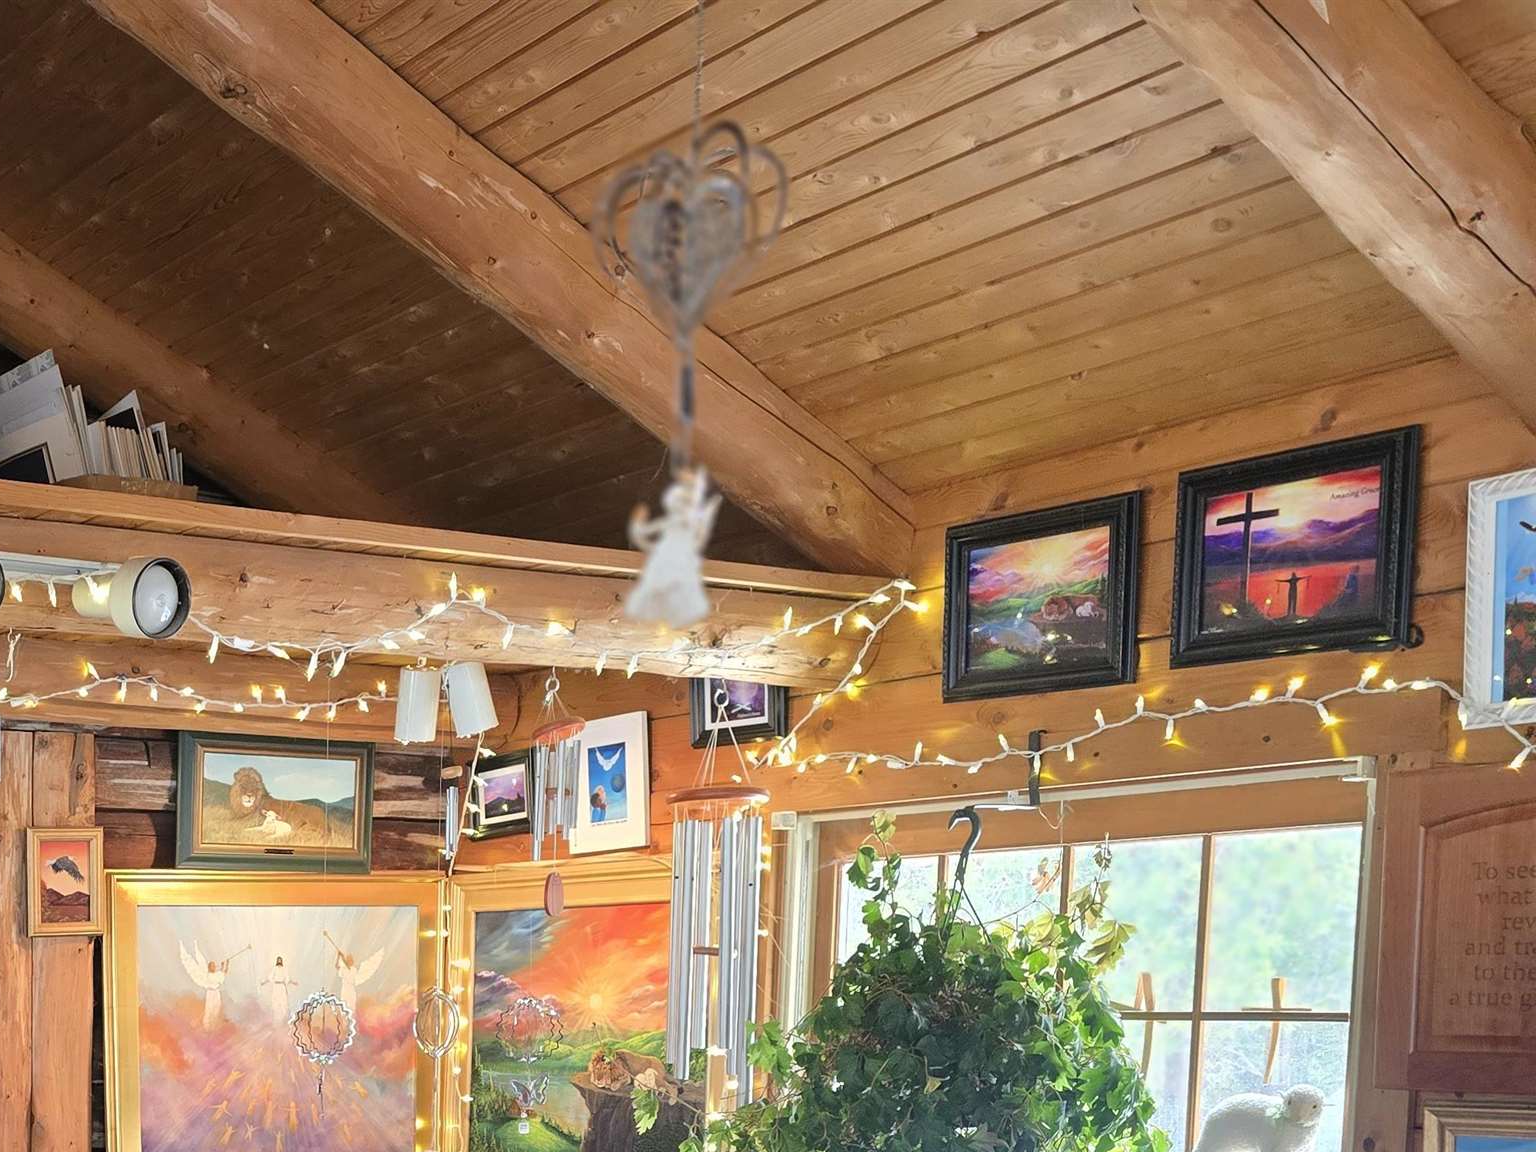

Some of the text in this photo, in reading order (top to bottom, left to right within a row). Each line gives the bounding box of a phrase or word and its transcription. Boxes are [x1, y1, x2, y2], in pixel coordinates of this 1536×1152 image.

[1472, 861, 1498, 881] To
[1477, 885, 1533, 905] what
[1465, 935, 1506, 956] and
[1474, 965, 1495, 982] to
[1449, 993, 1460, 1006] a
[1468, 991, 1513, 1007] true
